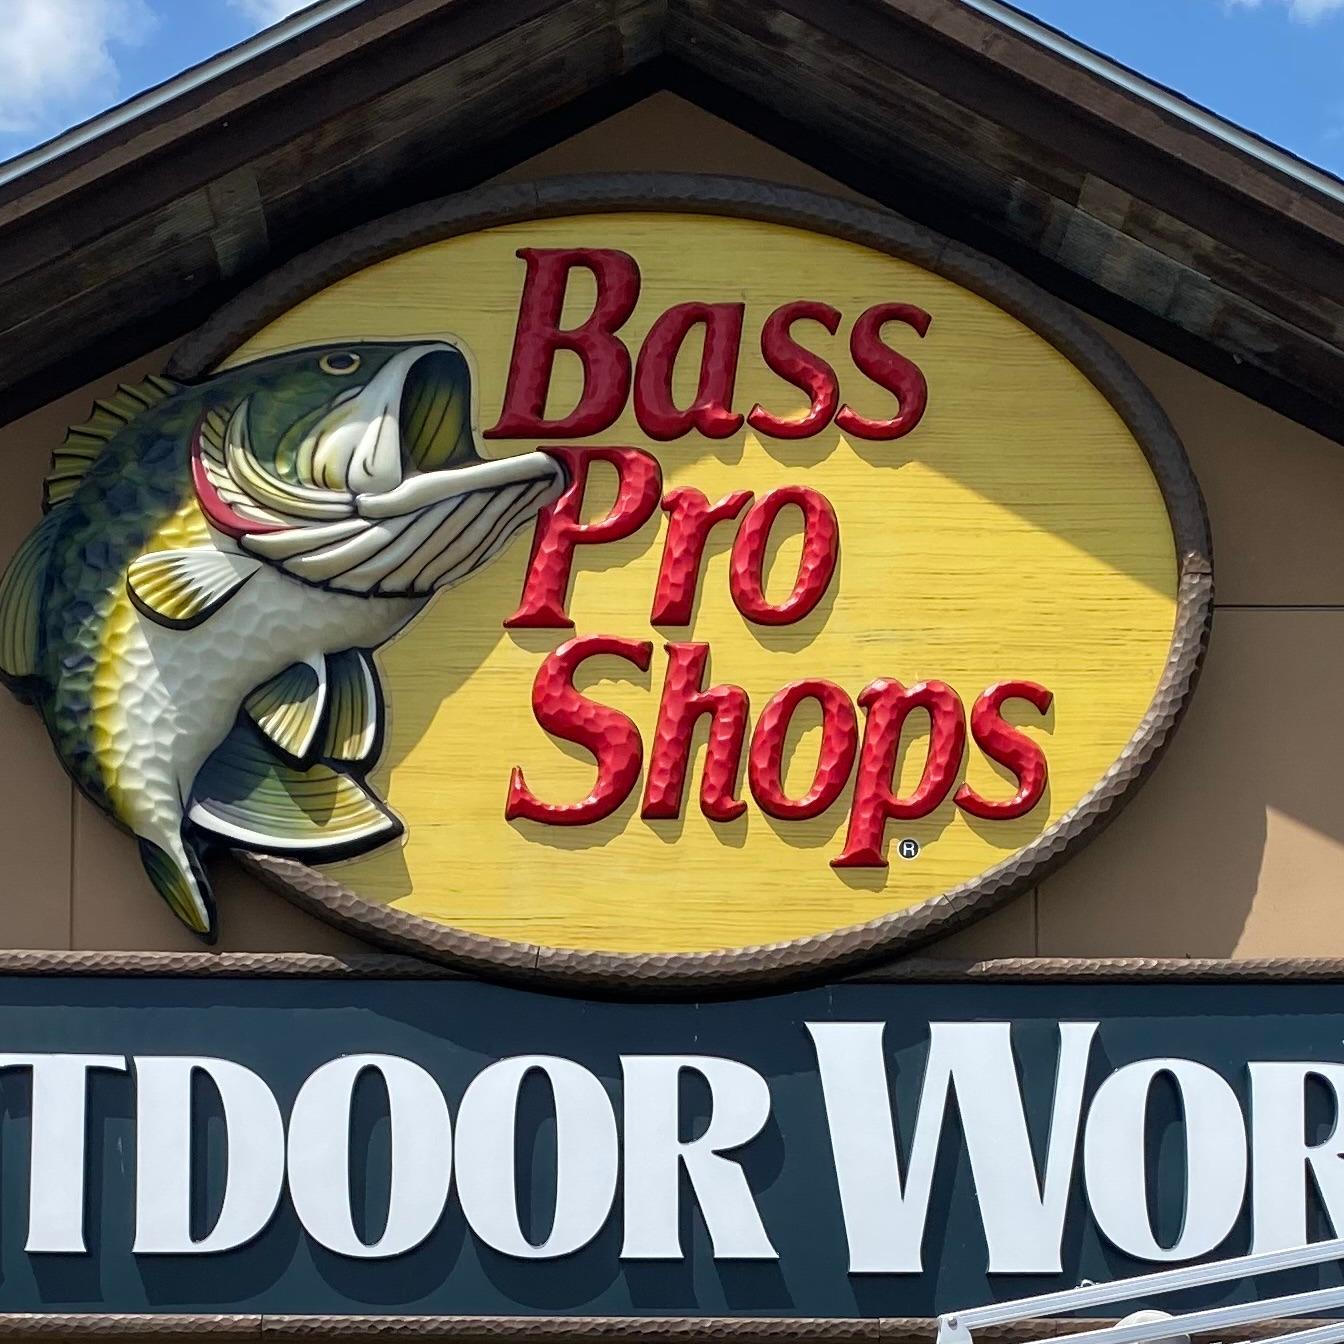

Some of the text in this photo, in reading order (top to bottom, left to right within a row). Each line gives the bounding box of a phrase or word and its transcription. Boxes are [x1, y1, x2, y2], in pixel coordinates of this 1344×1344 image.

[483, 247, 932, 441] Bass
[503, 445, 840, 629] Pro
[505, 634, 1054, 868] Shops
